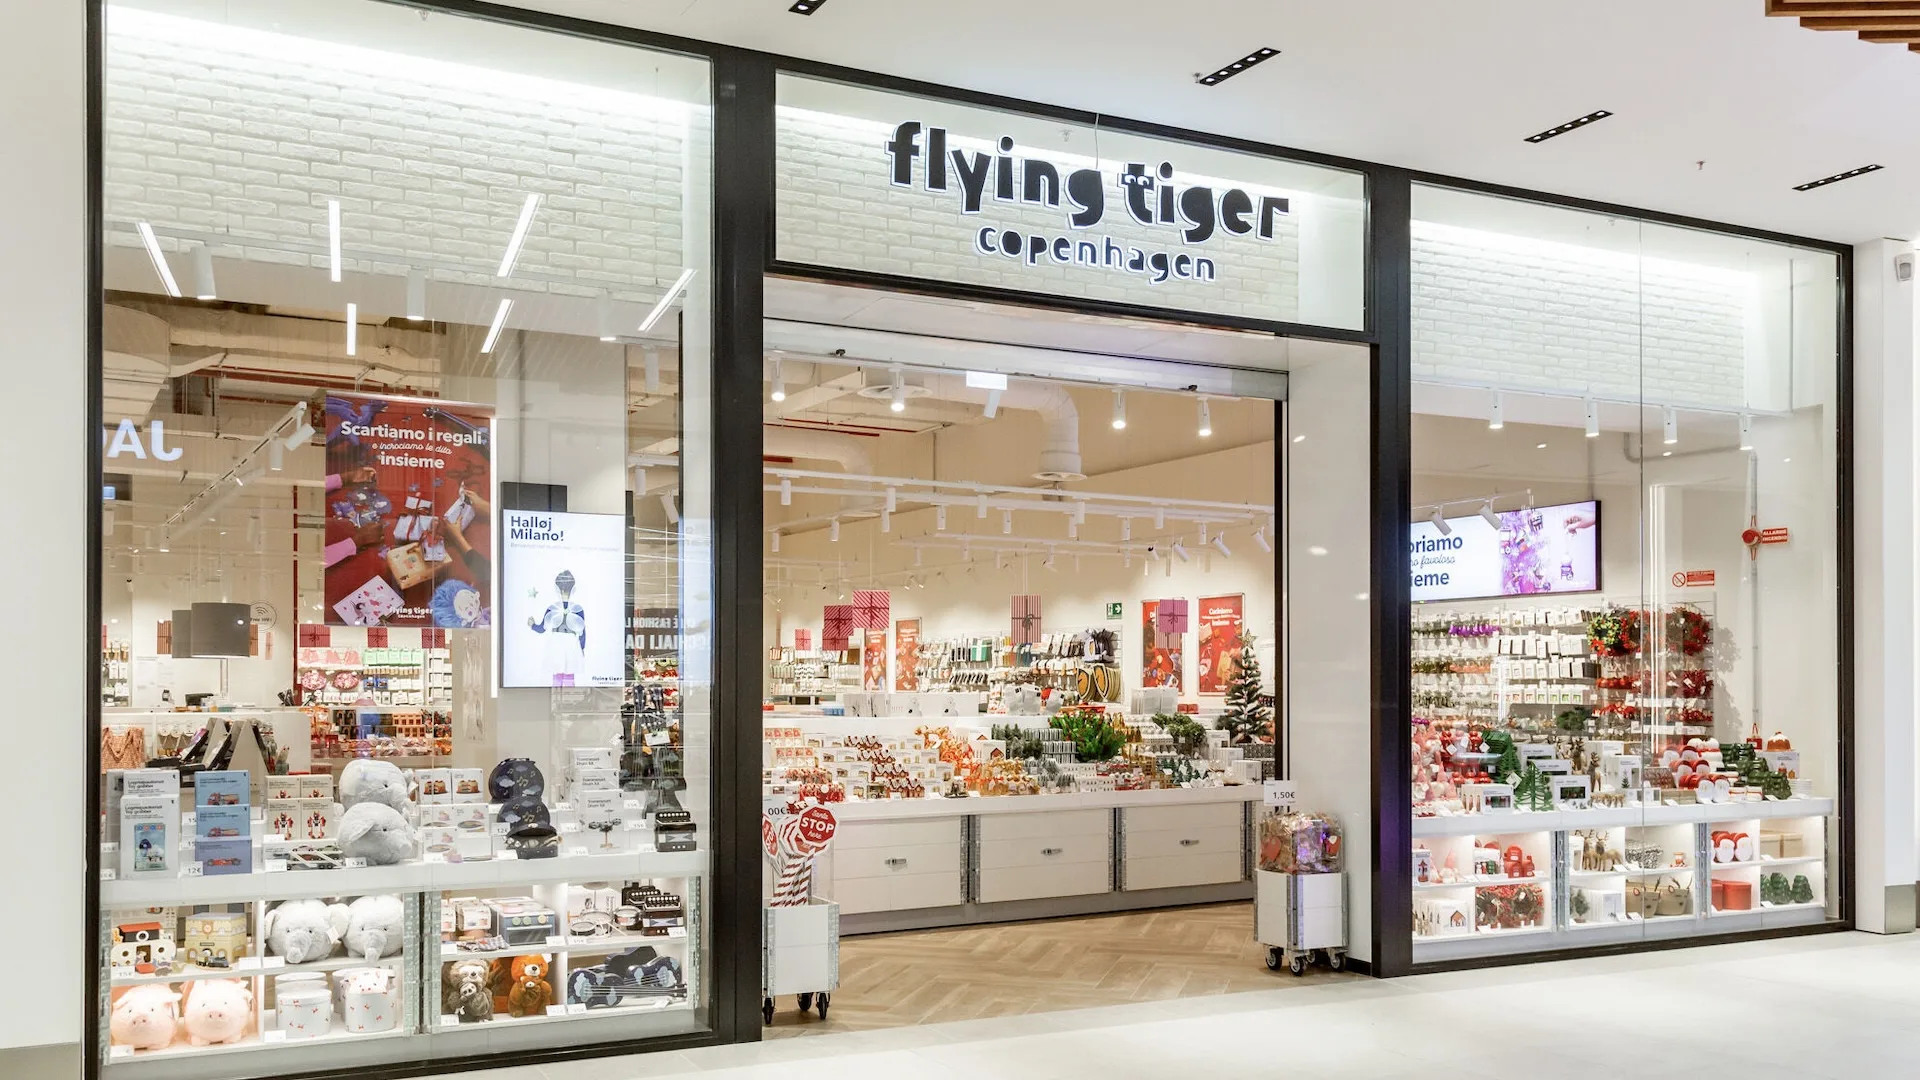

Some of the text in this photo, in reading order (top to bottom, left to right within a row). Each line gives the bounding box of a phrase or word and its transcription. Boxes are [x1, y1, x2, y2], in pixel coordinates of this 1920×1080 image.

[886, 121, 1290, 244] flying tiger
[976, 226, 1216, 284] copenhagen
[341, 420, 482, 446] Scartiamo i regali
[380, 452, 445, 469] insieme
[510, 515, 552, 531] Halløj
[510, 528, 564, 541] Milano!
[1272, 791, 1295, 800] 1,50€
[800, 816, 834, 833] STOP
